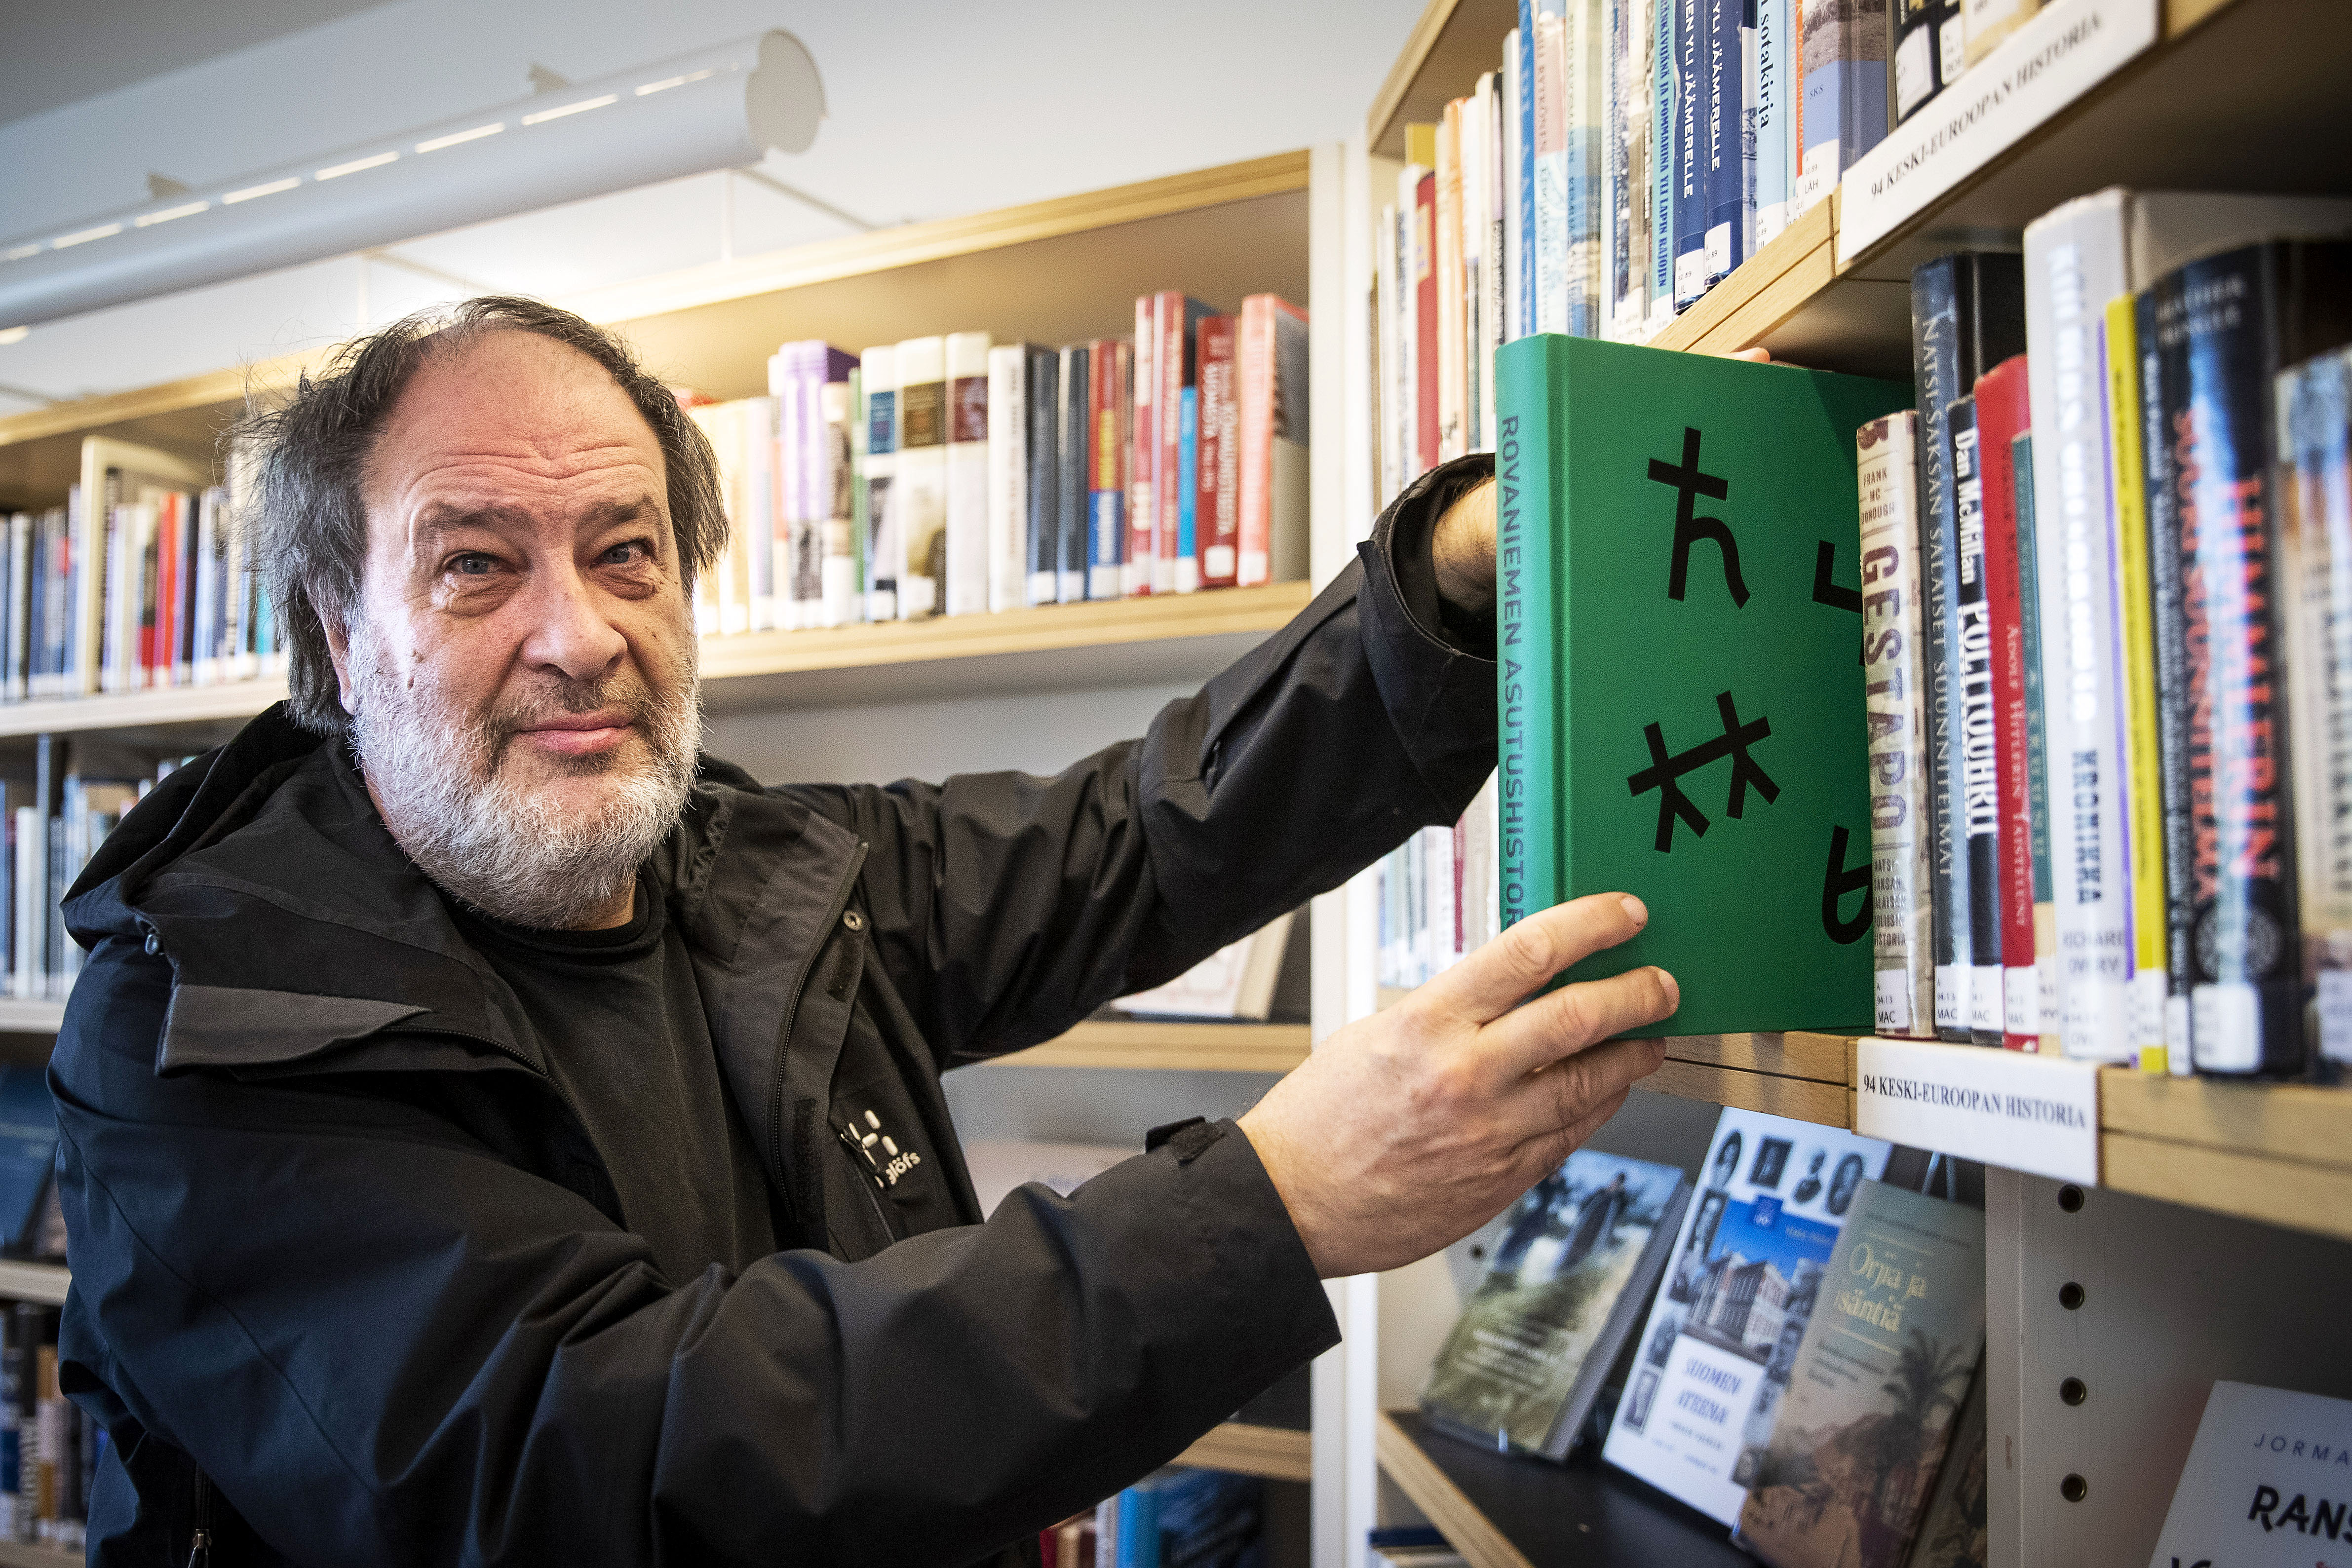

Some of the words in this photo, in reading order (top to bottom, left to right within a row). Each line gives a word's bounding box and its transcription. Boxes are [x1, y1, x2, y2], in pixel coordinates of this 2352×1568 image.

[1685, 34, 1694, 67] YLI
[1759, 13, 1774, 129] sotakirja
[1711, 39, 1724, 171] JÄÄMERELLE
[1809, 83, 1824, 100] SKS
[1870, 179, 1885, 198] 94
[1886, 79, 2014, 190] KESKI-EUROOPAN
[2015, 11, 2103, 89] HISTORIA
[1659, 98, 1669, 172] POMMARINA
[1683, 71, 1697, 198] JÄÄMERELLE
[1659, 176, 1668, 194] YLI
[1804, 179, 1818, 194] LÄH
[1658, 198, 1668, 233] LAPIN
[1658, 238, 1667, 287] RAJOJEN
[1922, 318, 1943, 515] NATSI-SAKSAN
[1863, 468, 1888, 487] FRANK
[1954, 427, 1979, 479] Dan
[1502, 414, 1522, 646] ROVANIEMEN
[1957, 479, 1985, 585] McMillan
[1929, 528, 1947, 657] SALAISET
[1862, 545, 1907, 831] GESTAPO
[1504, 658, 1525, 929] ASUTUSHISTOR
[1932, 663, 1955, 880] SUUNNITELMAT
[1878, 1011, 1895, 1023] MAC
[1937, 1009, 1959, 1020] MAC
[1863, 1074, 1876, 1094] 94
[1879, 1076, 2001, 1114] KESKI-EUROOPAN
[2006, 1095, 2086, 1129] HISTORIA
[2254, 1434, 2350, 1466] JORMA
[2247, 1484, 2352, 1544] RAN
